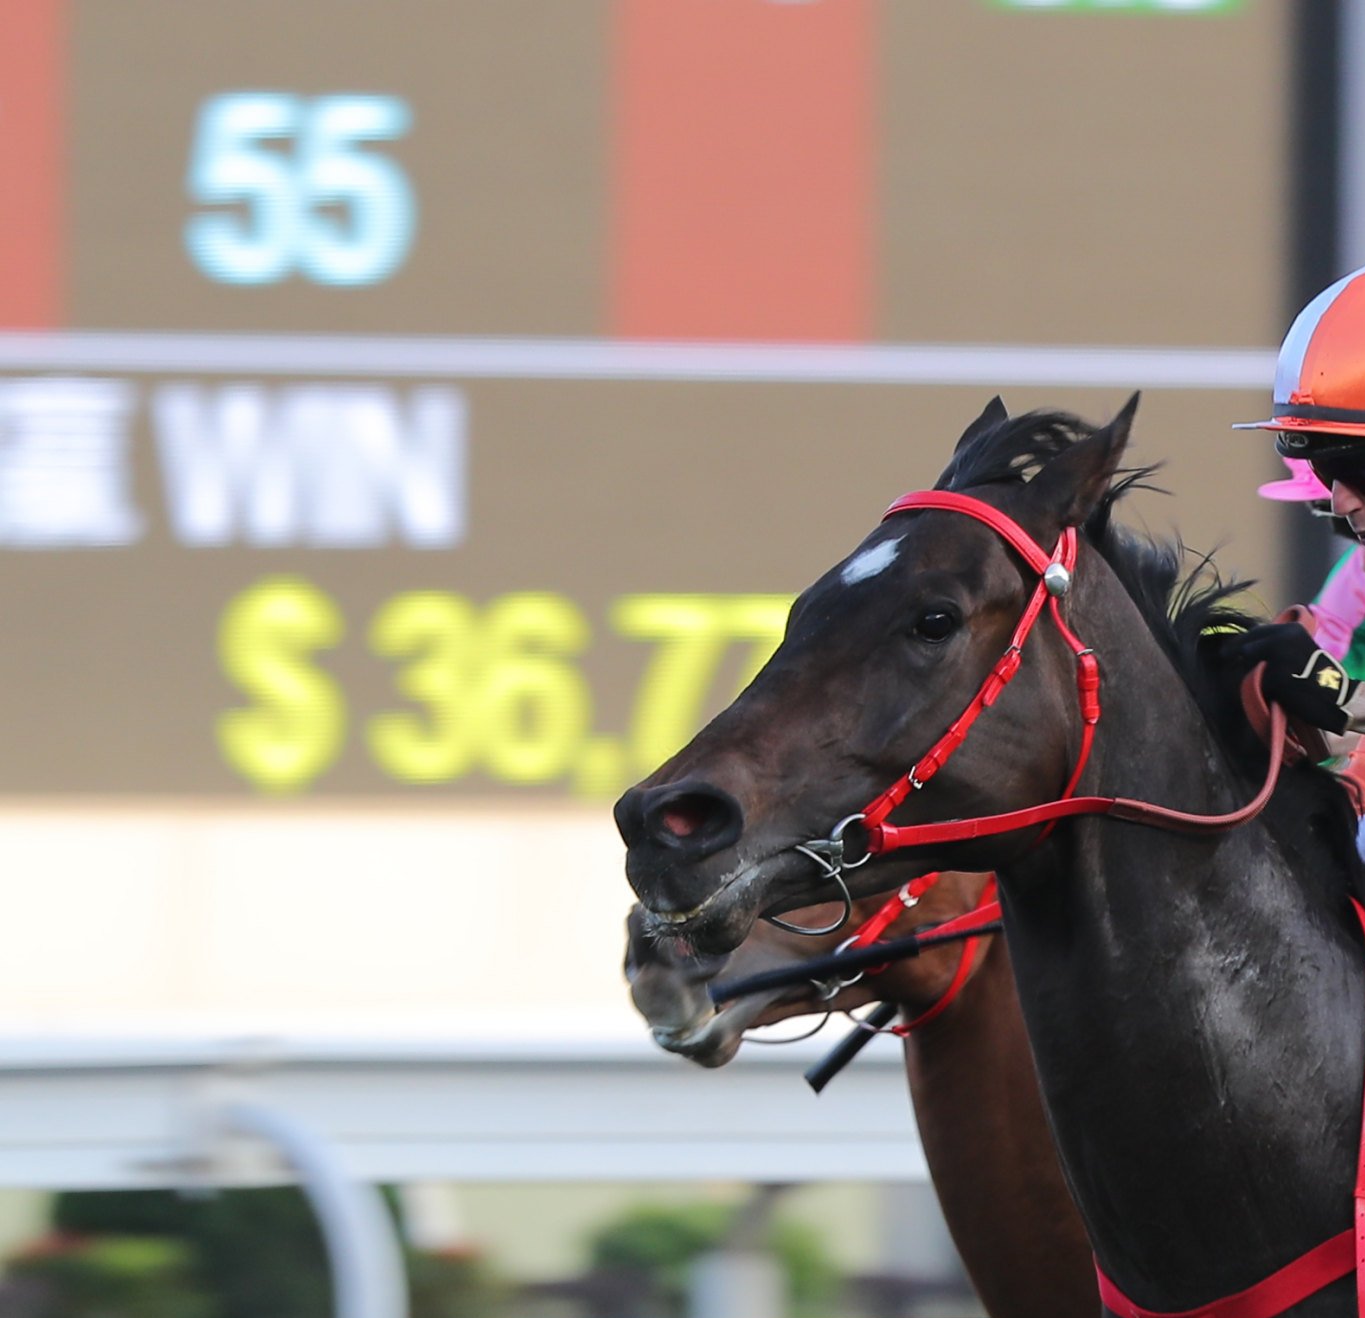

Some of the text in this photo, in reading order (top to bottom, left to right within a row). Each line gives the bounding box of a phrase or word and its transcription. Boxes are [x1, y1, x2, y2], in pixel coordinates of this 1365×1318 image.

[187, 92, 415, 285] 55
[152, 384, 470, 547] WIN
[217, 573, 347, 792] $
